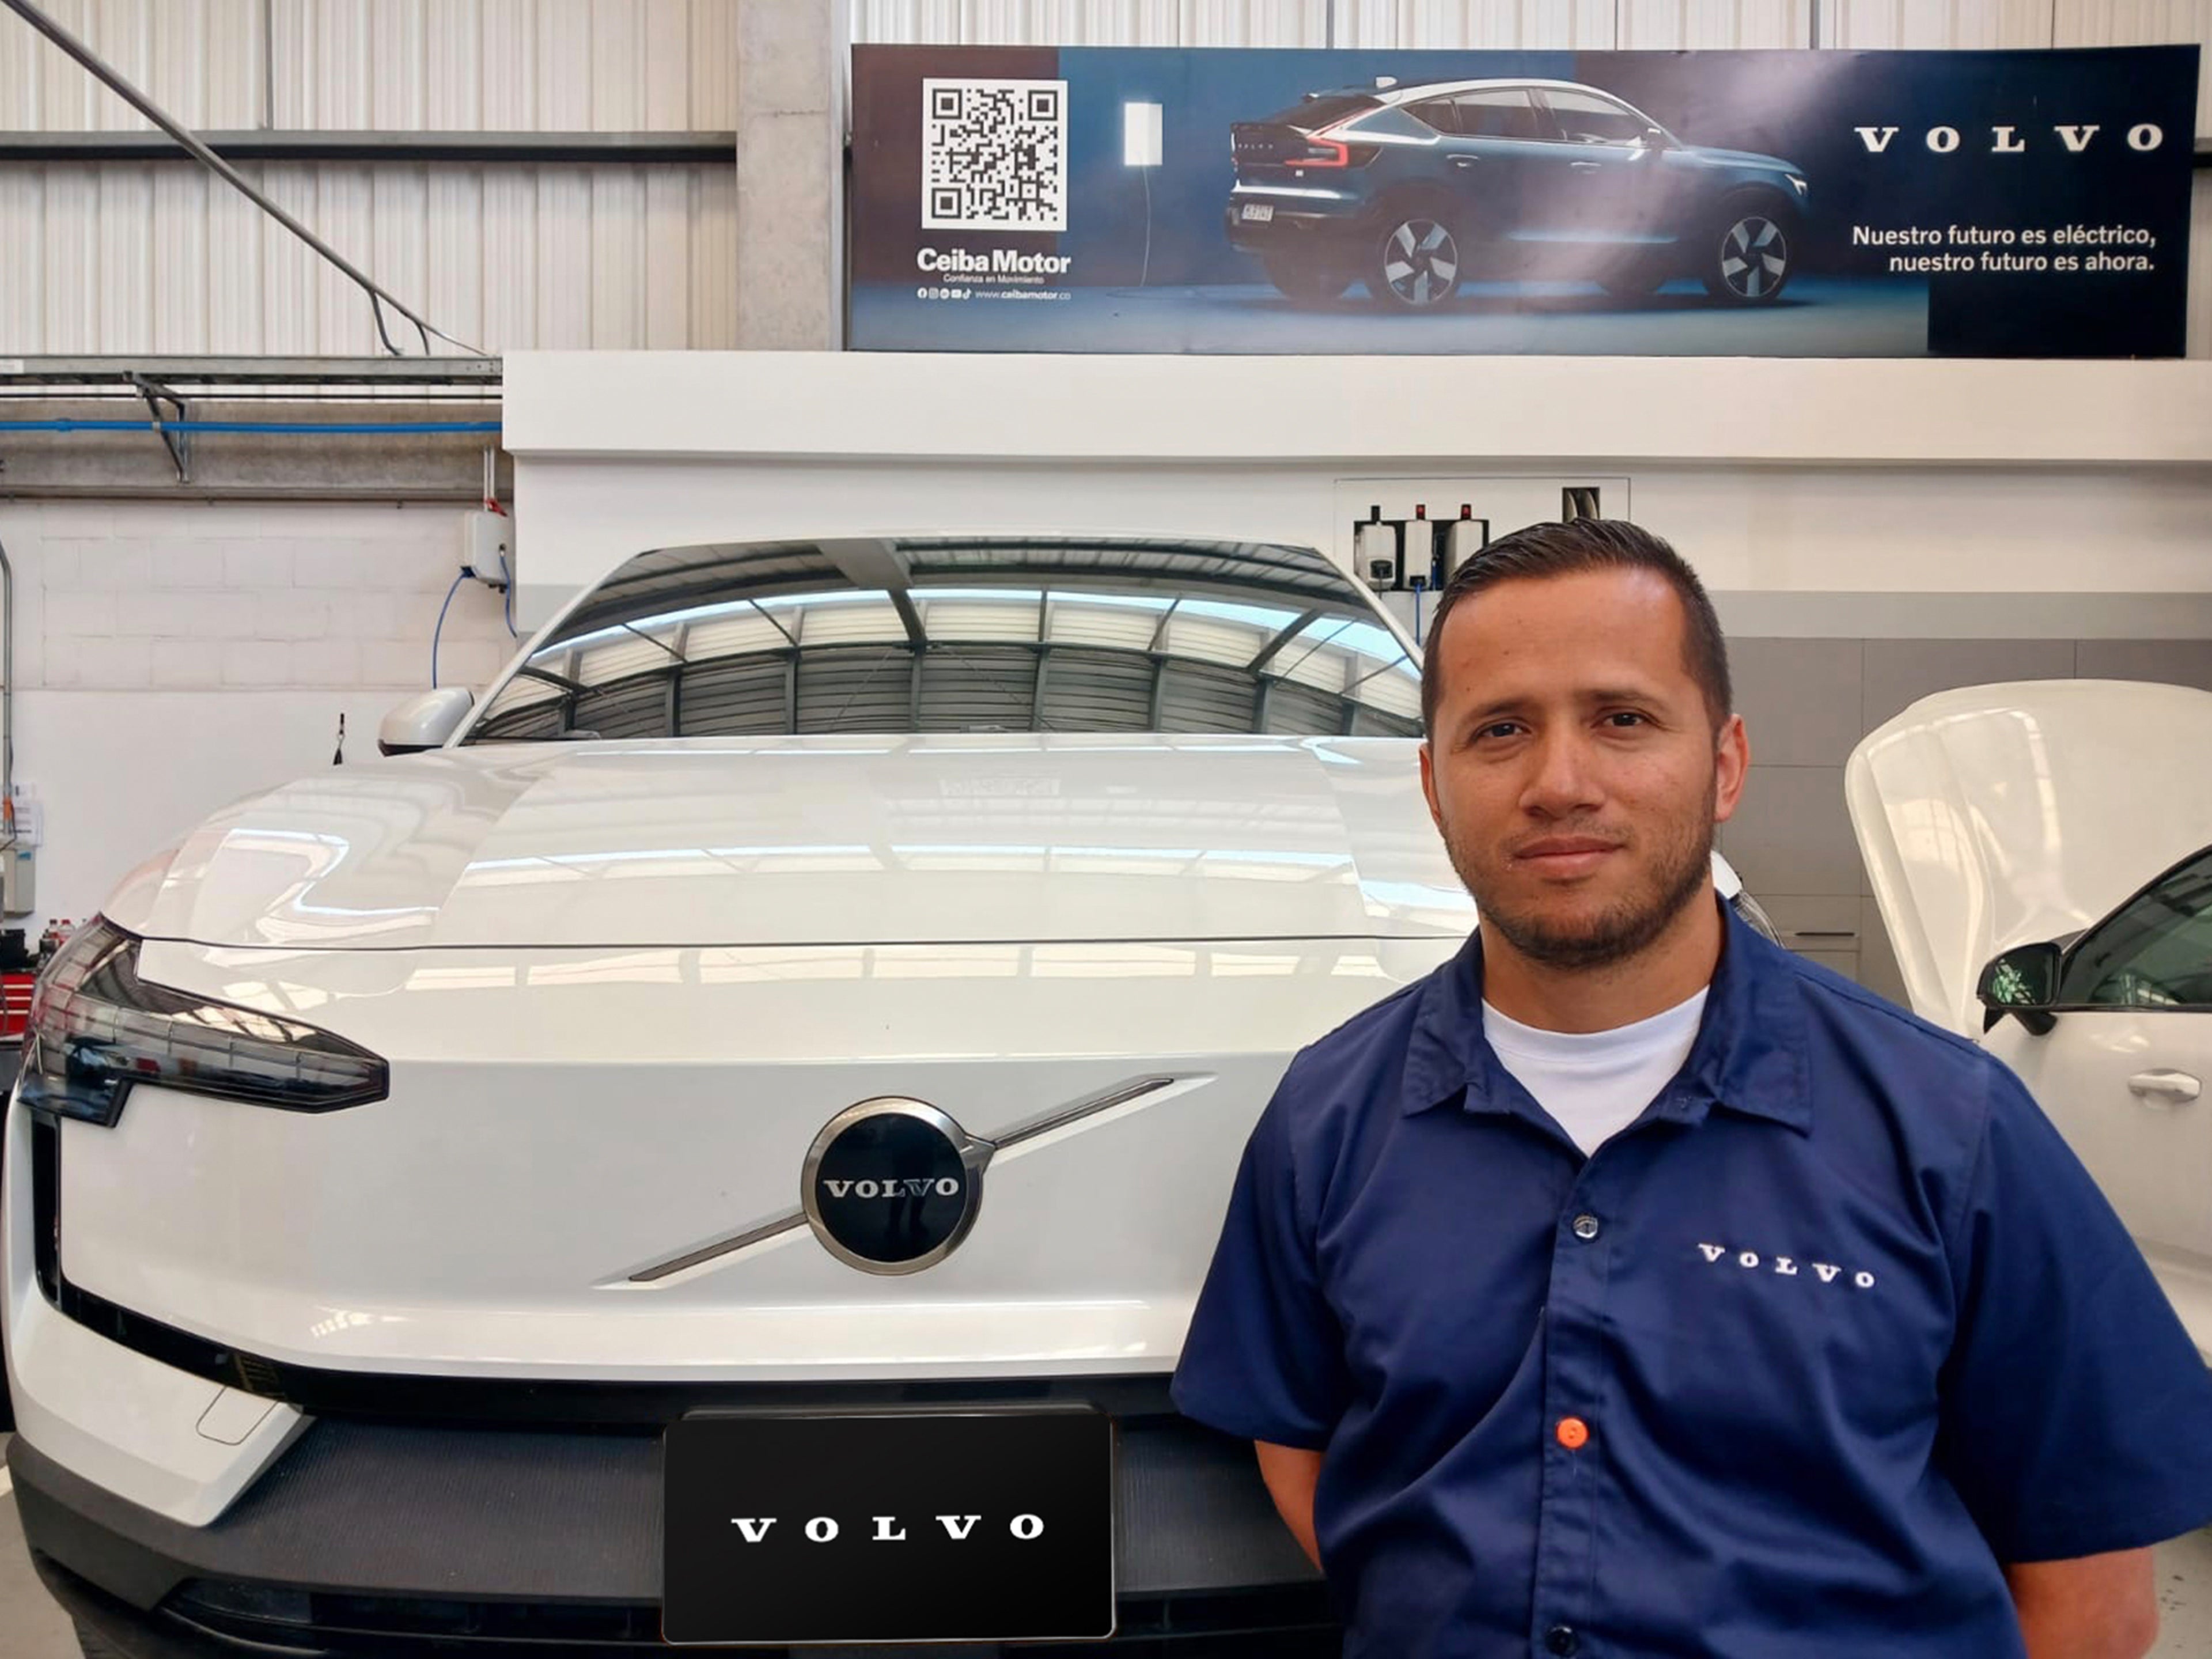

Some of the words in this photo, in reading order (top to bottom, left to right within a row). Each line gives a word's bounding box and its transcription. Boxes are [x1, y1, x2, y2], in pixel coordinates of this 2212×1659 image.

[1854, 123, 2163, 153] VOLVO
[1853, 225, 1942, 245] Nuestro
[1948, 225, 2016, 244] futuro
[2021, 230, 2047, 244] es
[2052, 224, 2156, 248] eléctrico,
[917, 248, 988, 272] Ceiba
[993, 249, 1071, 272] Motor
[1889, 252, 1975, 271] nuestro
[1980, 251, 2048, 271] futuro
[2054, 256, 2080, 271] es
[2085, 251, 2155, 271] ahora.
[943, 273, 984, 283] Confianza
[997, 275, 1045, 284] Movimiento
[823, 1177, 959, 1198] VOLVO
[1698, 1243, 1874, 1288] VOLVO
[731, 1513, 1044, 1543] VOLVO
